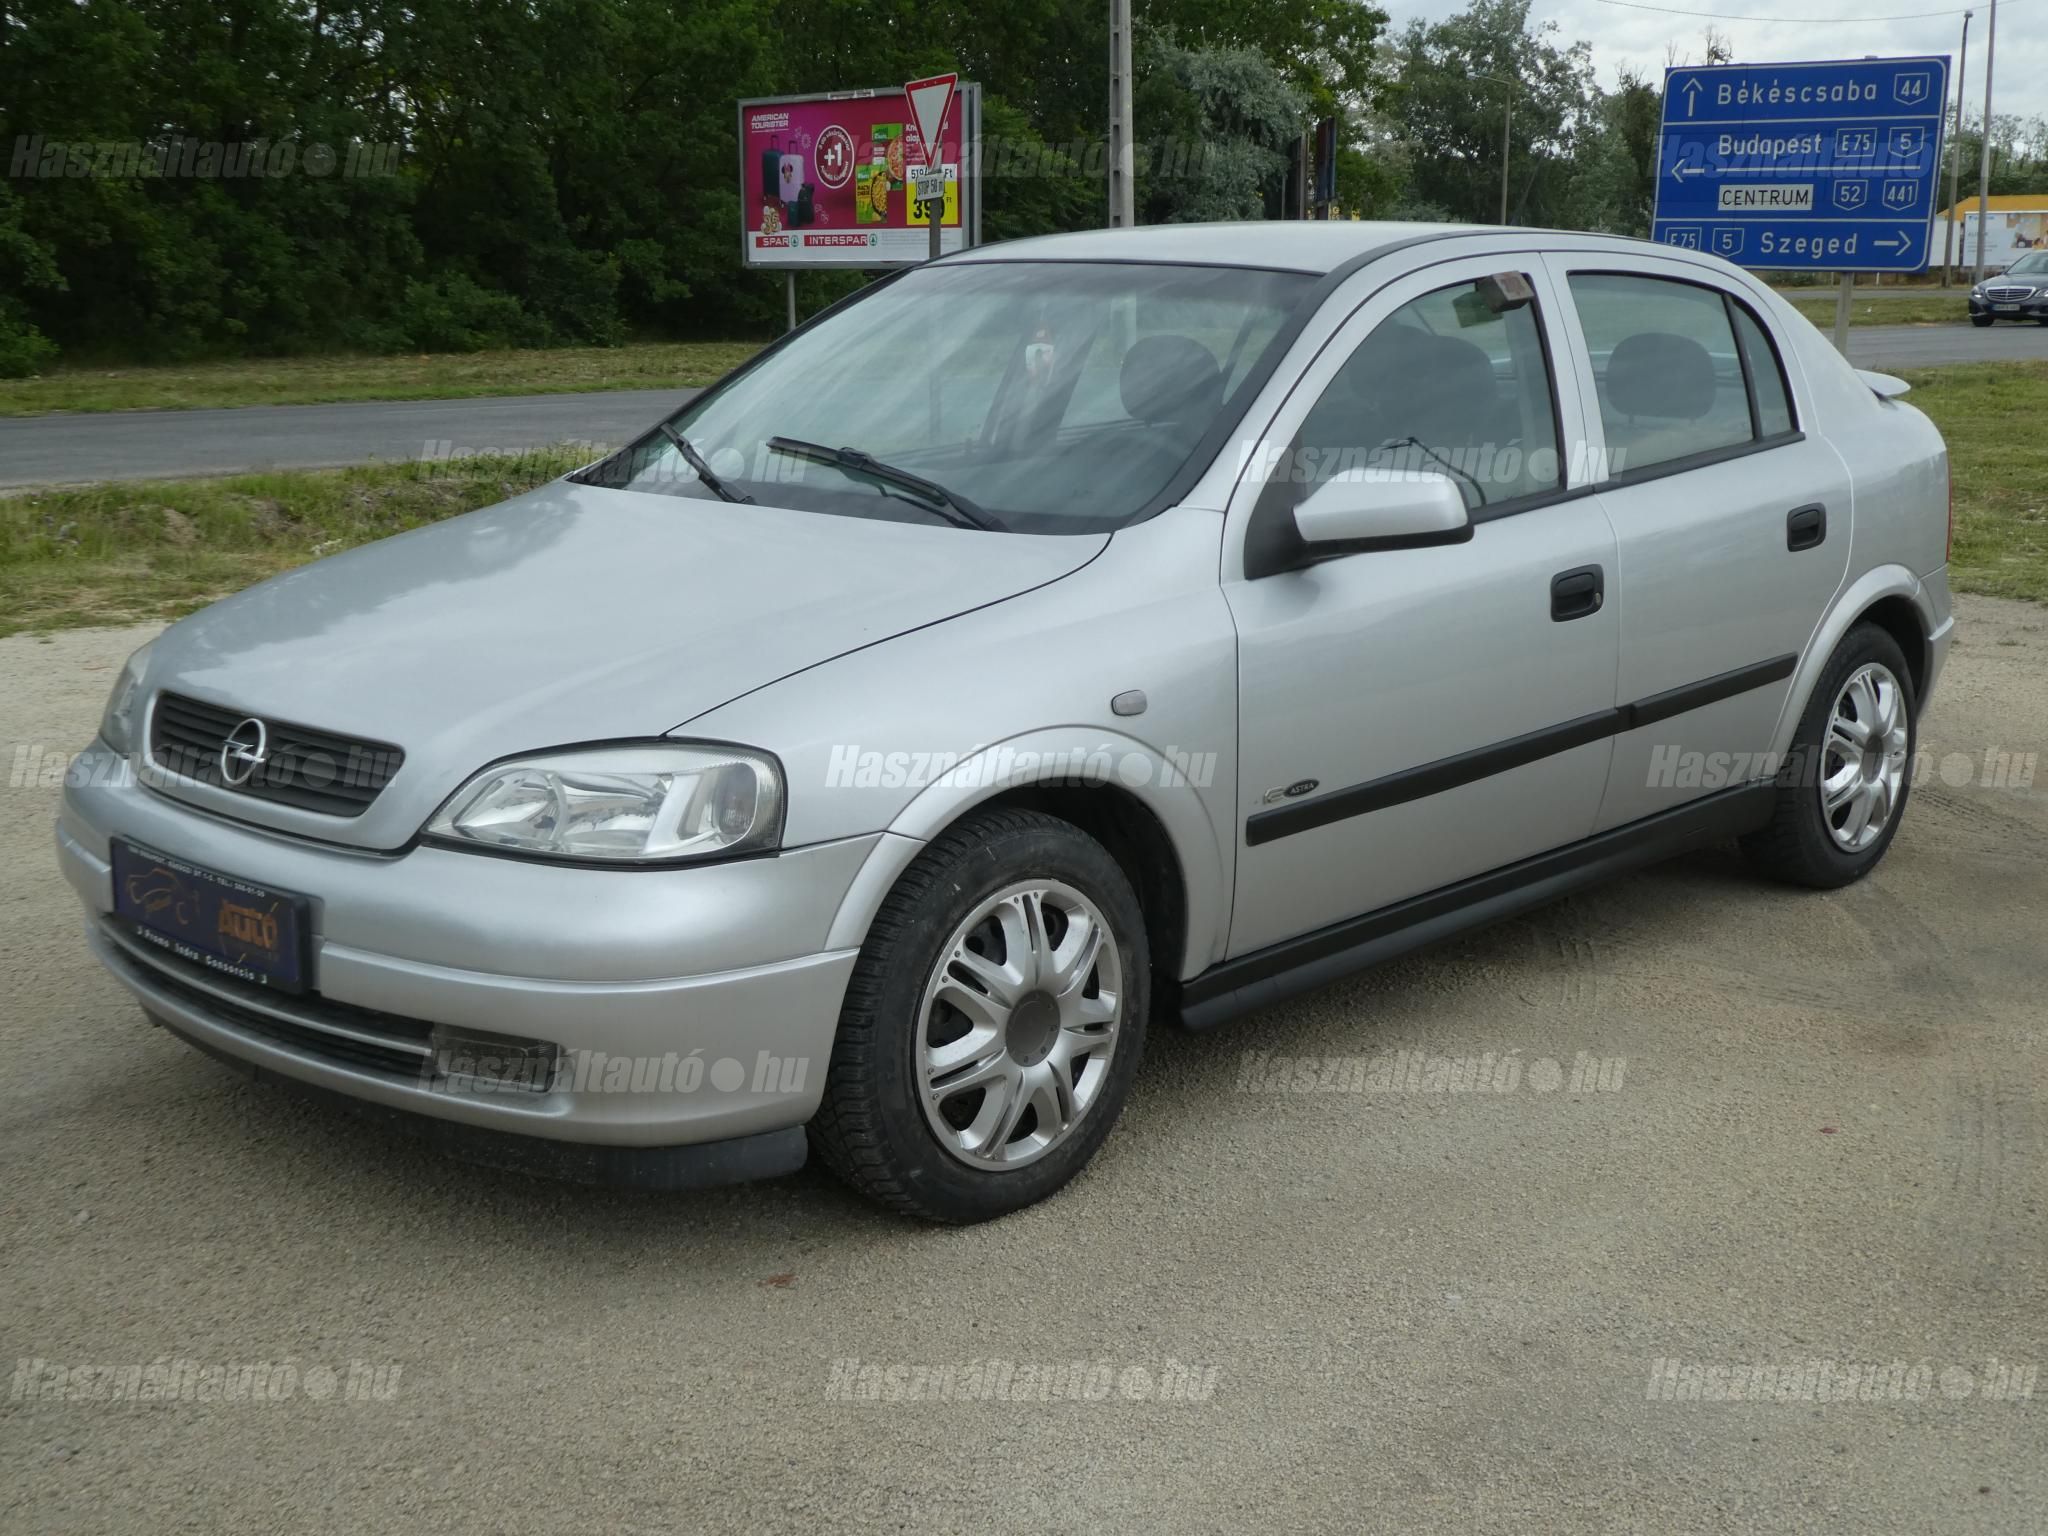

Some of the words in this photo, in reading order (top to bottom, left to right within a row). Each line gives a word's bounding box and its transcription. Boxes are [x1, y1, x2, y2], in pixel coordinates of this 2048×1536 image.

[1717, 79, 1877, 105] Békéscsaba
[1901, 80, 1921, 97] 44
[752, 113, 789, 122] AMERICAN
[752, 120, 788, 129] TOURISTER
[1718, 133, 1822, 159] Budapest
[1900, 133, 1912, 150] 5
[824, 142, 842, 167] +1
[1722, 189, 1809, 206] CENTRUM
[1840, 186, 1860, 202] 52
[1887, 186, 1913, 202] 441
[763, 237, 789, 246] SPAR
[809, 235, 867, 246] INTERSPAR
[1722, 233, 1733, 249] 5
[1760, 231, 1858, 259] Szeged
[1290, 782, 1314, 794] ASTRA
